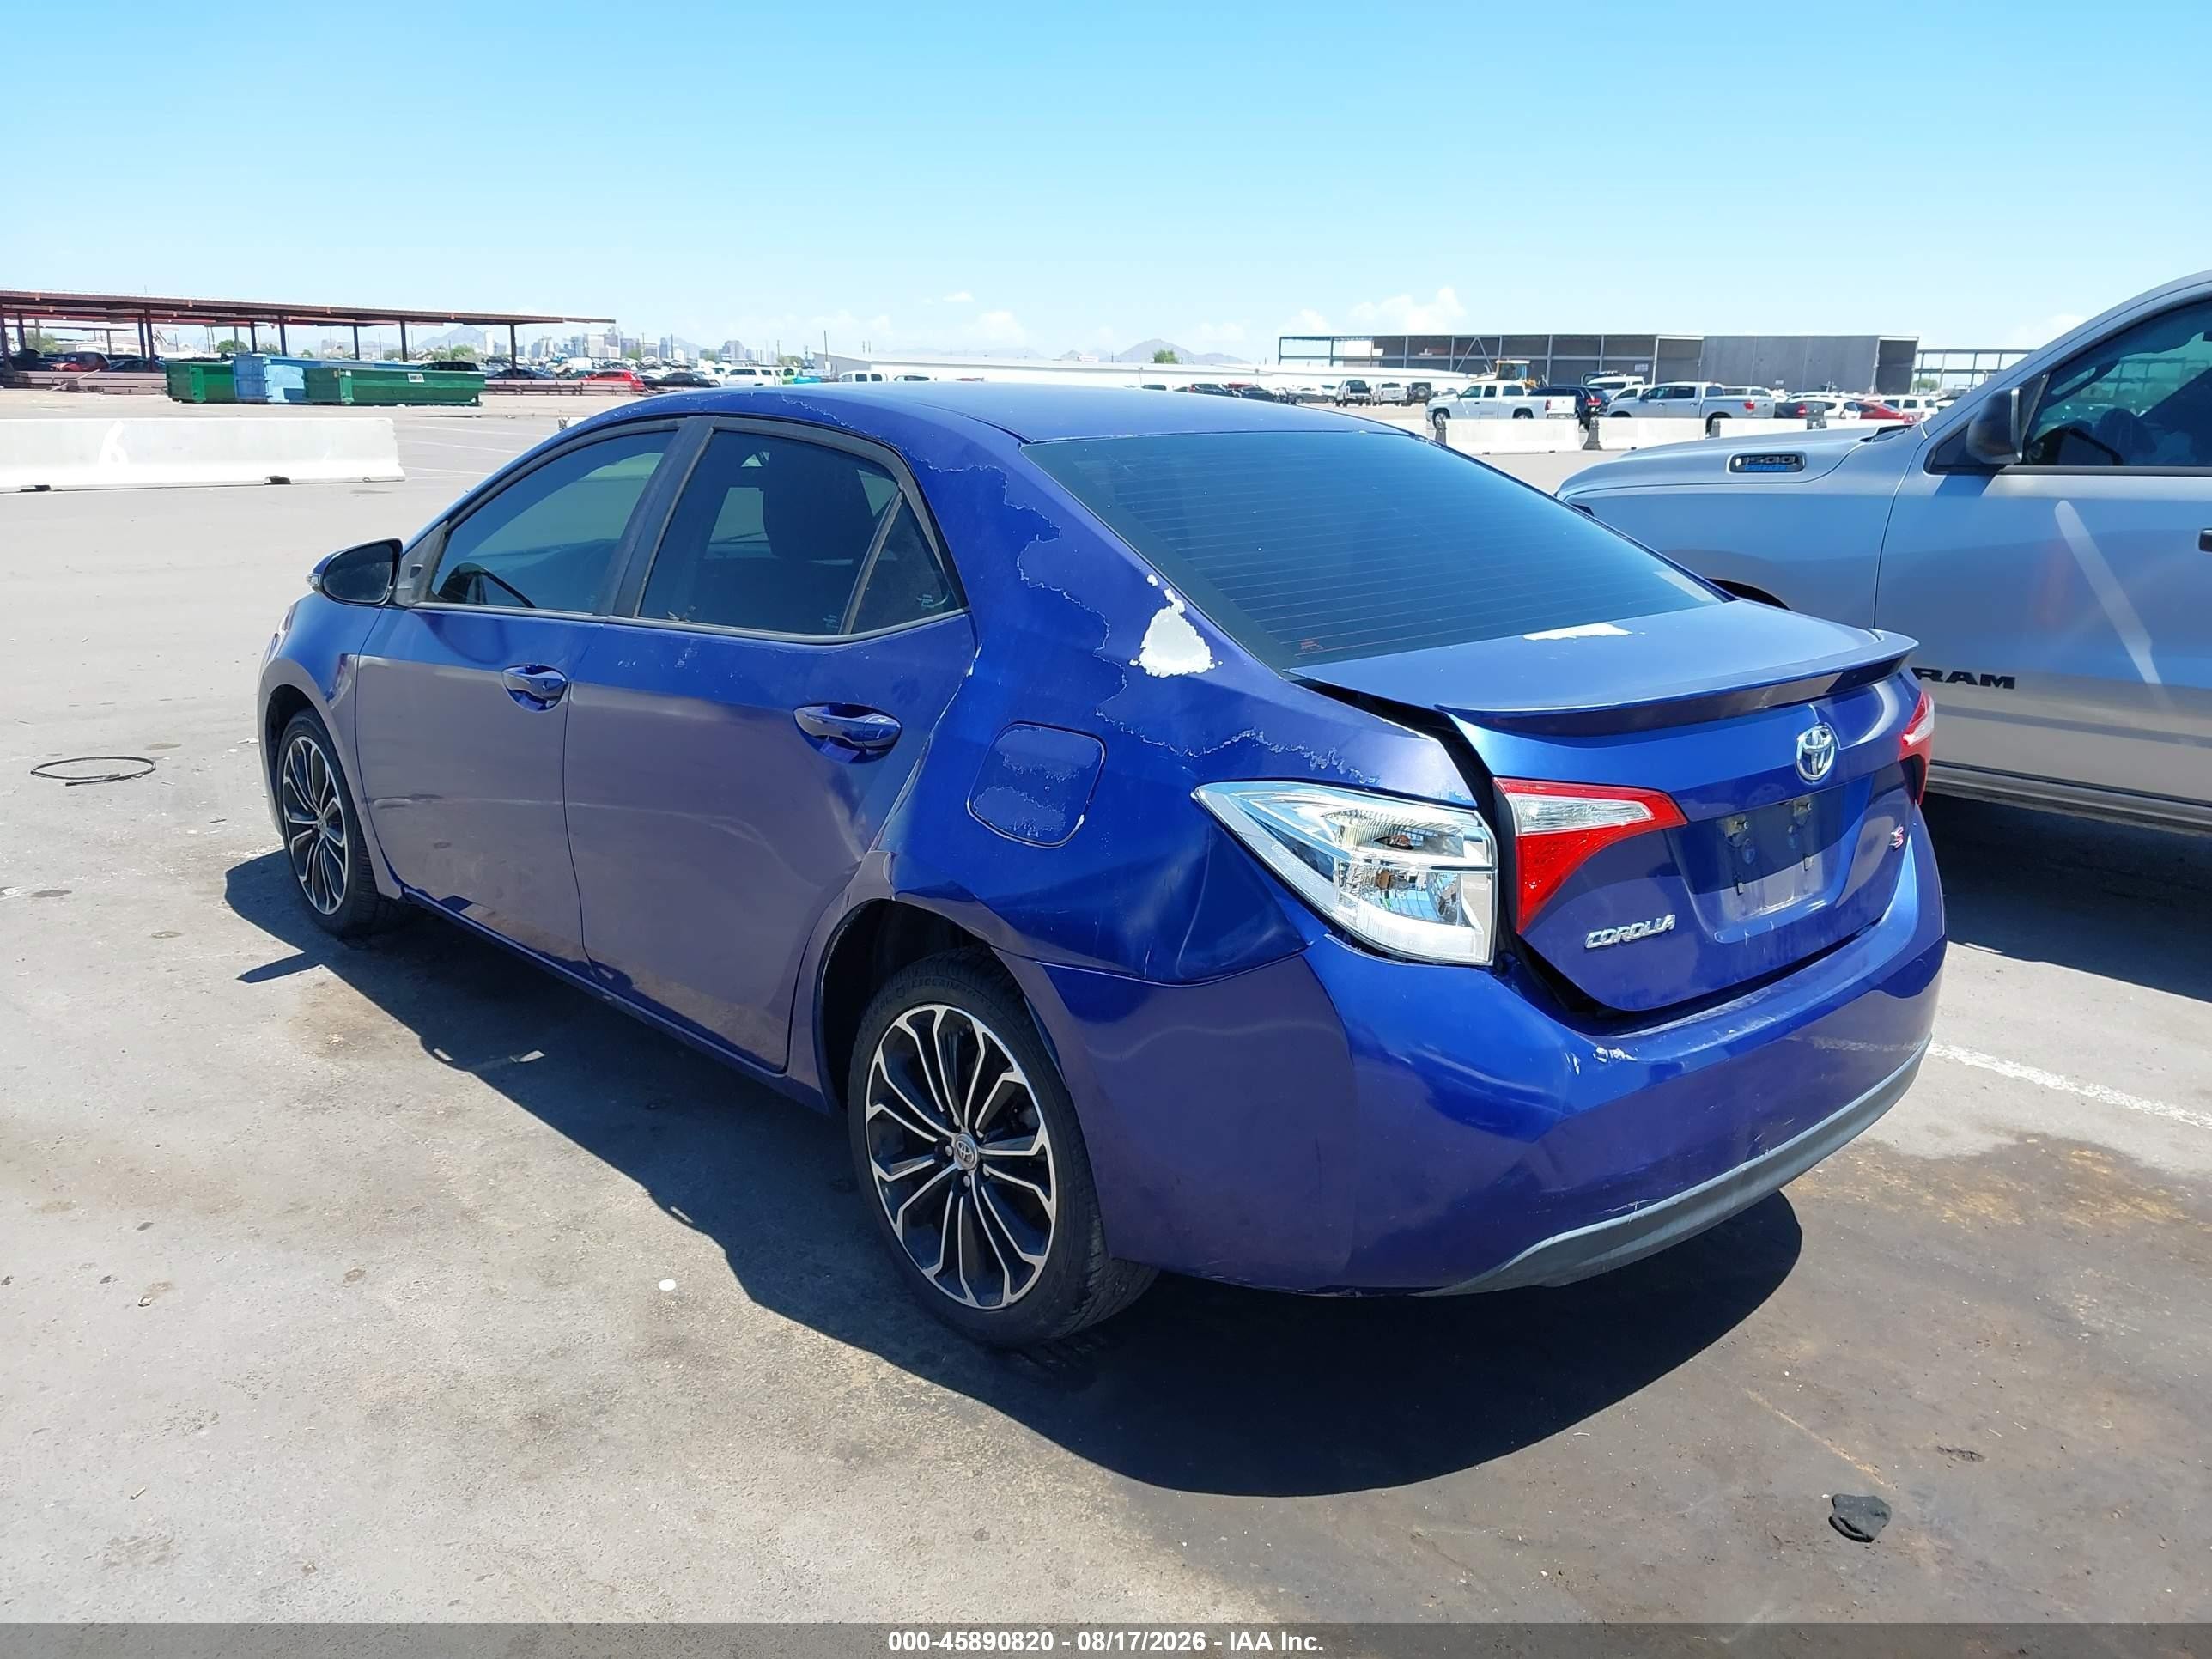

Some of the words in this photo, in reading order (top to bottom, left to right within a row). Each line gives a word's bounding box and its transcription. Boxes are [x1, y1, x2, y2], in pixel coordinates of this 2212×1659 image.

[1911, 667, 2015, 690] RAM
[1890, 825, 1904, 848] S
[1585, 915, 1676, 949] COROLLA
